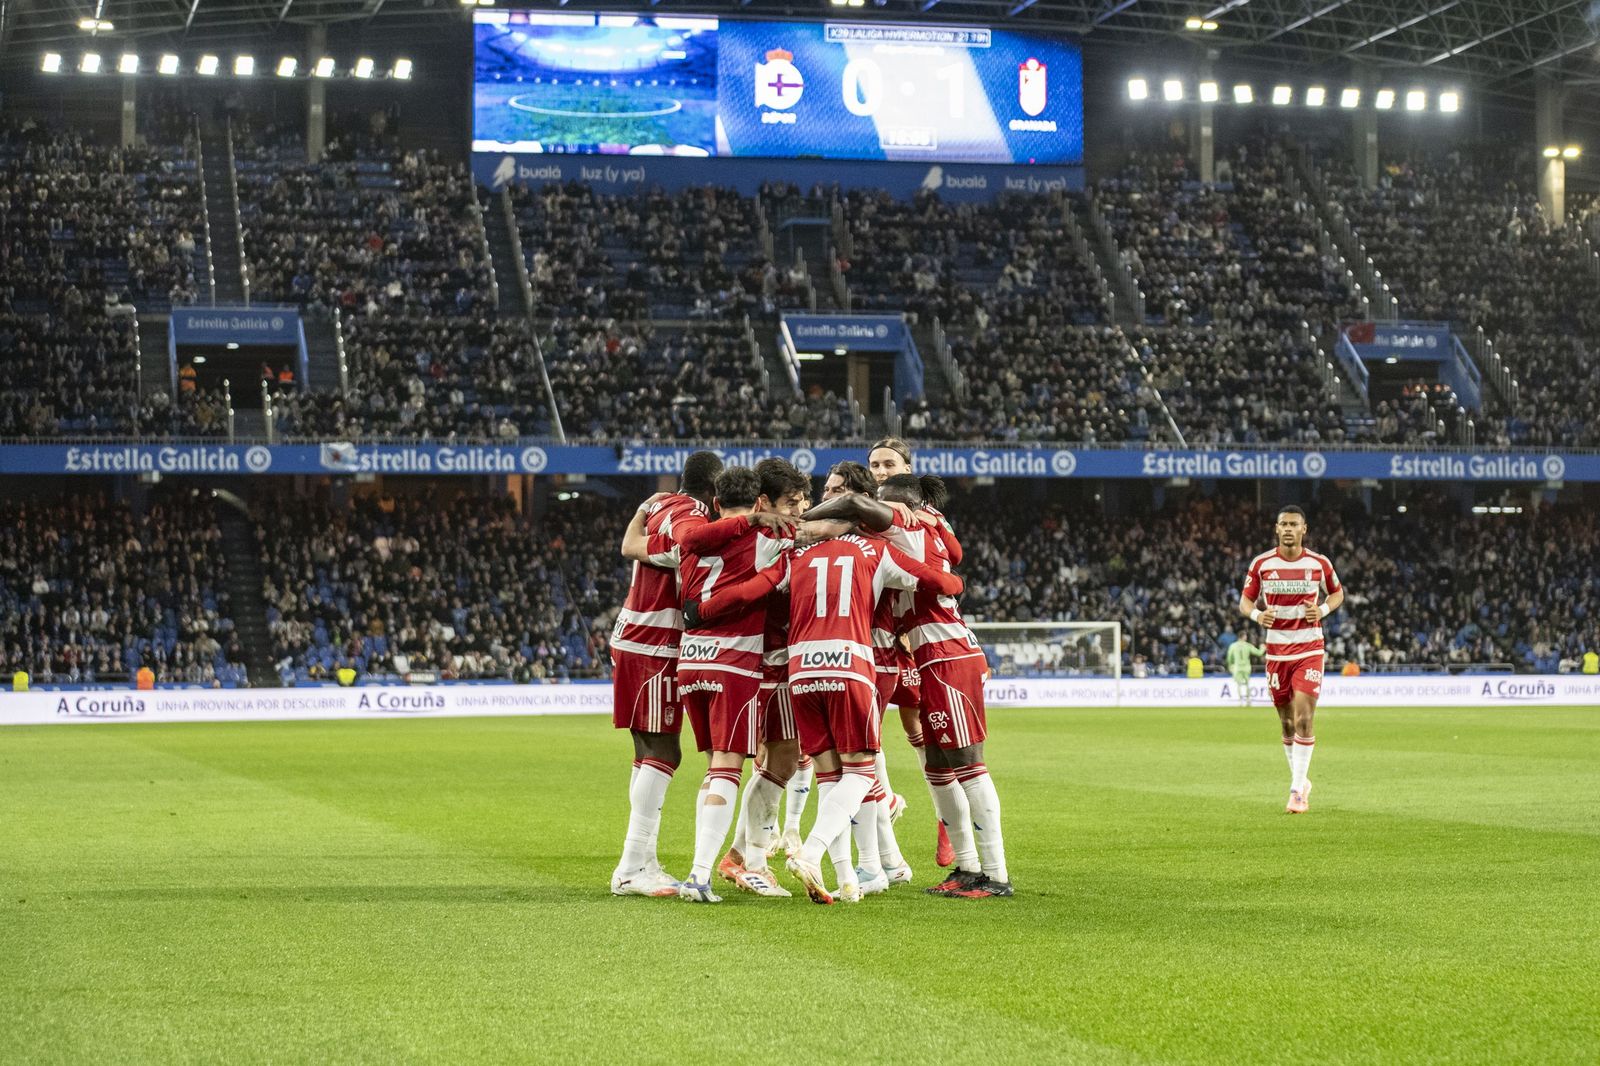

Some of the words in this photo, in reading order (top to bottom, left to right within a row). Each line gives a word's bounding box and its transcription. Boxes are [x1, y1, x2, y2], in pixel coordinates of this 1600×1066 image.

[850, 29, 883, 40] LALIGA
[842, 59, 882, 116] 0
[936, 62, 964, 118] 1
[582, 166, 602, 179] luz
[1005, 176, 1026, 189] luz
[187, 317, 229, 330] Estrella
[231, 317, 269, 330] Galicia
[65, 447, 153, 471] Estrella
[158, 447, 240, 471] Galicia
[435, 447, 516, 472] Galicia
[618, 449, 690, 473] Estrell
[911, 452, 967, 474] trella
[971, 451, 1046, 475] Galicia
[1142, 452, 1222, 475] Estrella
[1225, 453, 1298, 476] Galicia
[1390, 455, 1465, 478] Estrella
[1469, 455, 1538, 478] Galicia
[696, 555, 724, 603] 7
[808, 556, 854, 618] 11
[1071, 688, 1126, 699] PROVINCA
[1129, 688, 1148, 699] POR
[1153, 687, 1210, 699] DESCUBRIR
[1220, 684, 1232, 698] A
[1339, 686, 1392, 697] PROVINCIA
[1395, 686, 1414, 697] POR
[1417, 685, 1472, 696] DESCUBRIR
[1481, 681, 1492, 696] A
[1497, 679, 1555, 696] Coruña
[57, 697, 69, 713] A
[76, 695, 145, 713] Coruña
[156, 700, 190, 712] UNHA
[193, 700, 254, 712] PROVINCIA
[257, 699, 279, 711] POR
[283, 698, 346, 710] DESCUBRIR
[358, 693, 371, 708] A
[377, 691, 445, 708] Coruña
[456, 695, 489, 707] UNHA
[492, 695, 550, 706] PROVINCIA
[554, 694, 577, 706] POR
